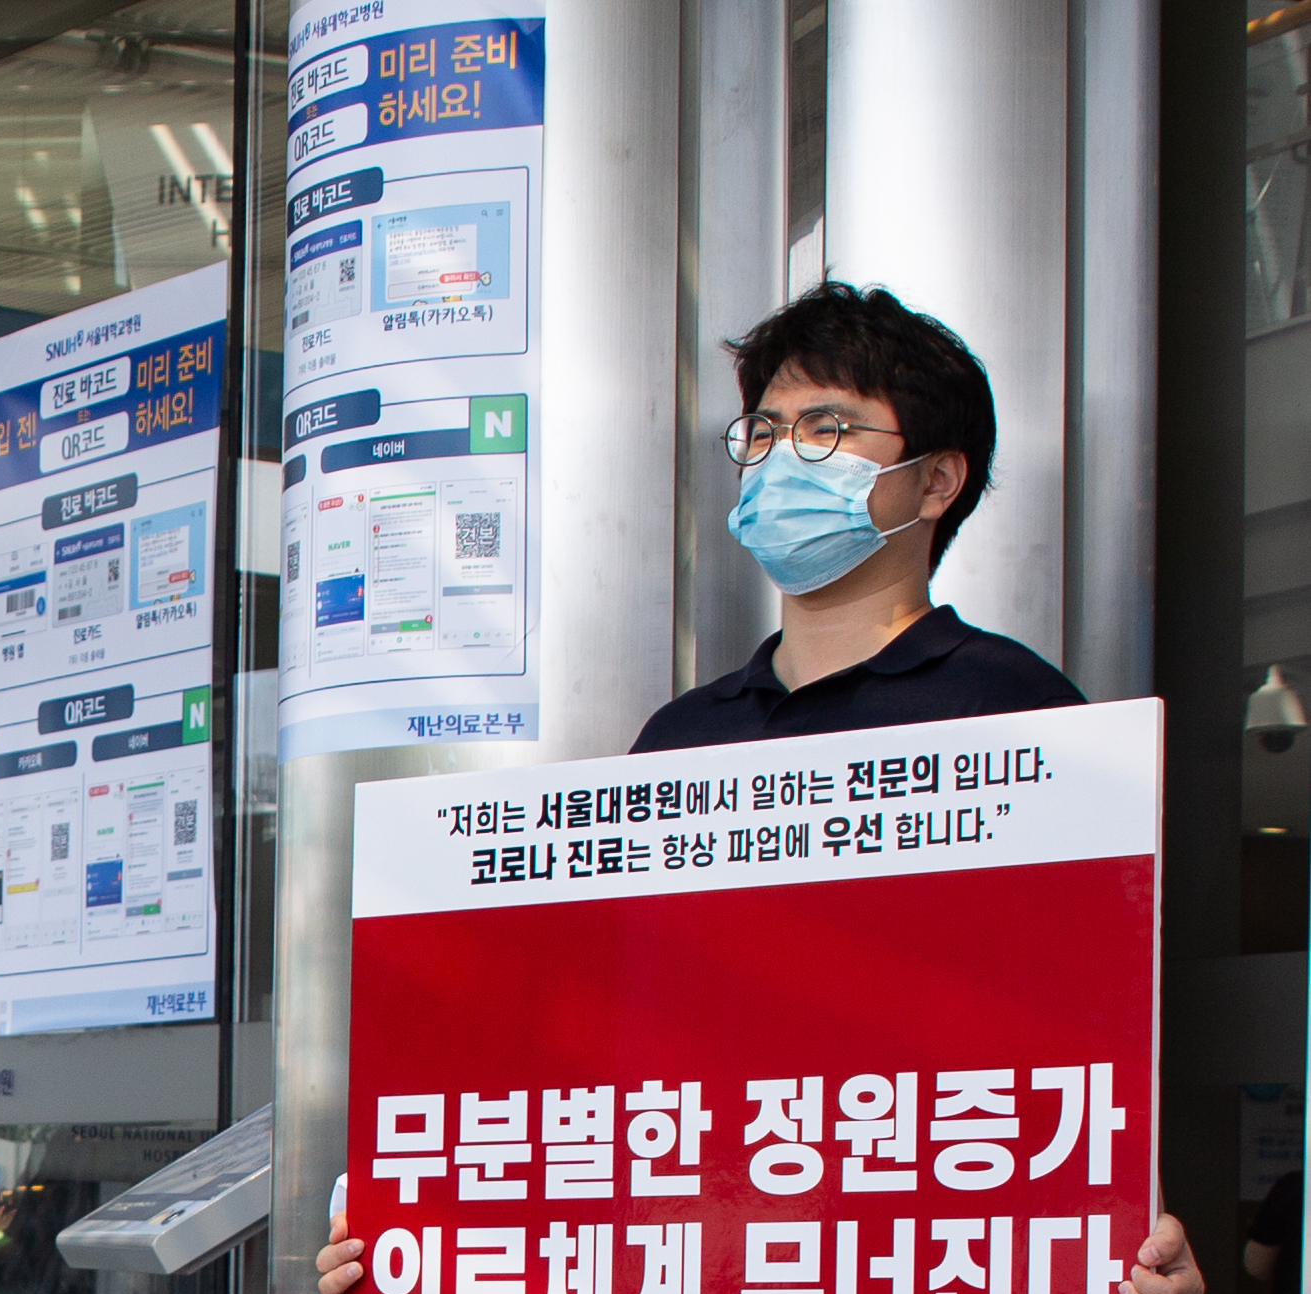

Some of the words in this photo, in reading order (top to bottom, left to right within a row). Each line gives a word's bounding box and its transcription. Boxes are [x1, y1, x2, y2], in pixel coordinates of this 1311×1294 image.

[312, 1, 384, 38] 서울대학교병원
[379, 38, 437, 82] 미리
[450, 30, 518, 74] 준비
[307, 57, 349, 94] 바코드
[378, 81, 482, 128] 하세요!
[294, 119, 336, 162] QR코드
[312, 179, 353, 214] 바코드
[382, 305, 493, 332] 알림톡(카카오톡)
[46, 337, 76, 362] SNUH
[137, 350, 170, 392] 미리
[177, 337, 213, 382] 준비
[80, 366, 117, 400] 바코드
[135, 386, 194, 437] 하세요!
[296, 403, 338, 438] QR코드
[484, 410, 513, 438] N
[17, 412, 37, 450] 전!
[62, 424, 106, 461] QR코드
[372, 439, 405, 458] 네이버
[84, 483, 119, 515] 바코드
[136, 601, 197, 630] 알림톡(카카오톡)
[65, 695, 107, 727] QR코드
[190, 701, 205, 730] N
[408, 712, 525, 738] 재난의료본부
[536, 777, 739, 831] 서울대병원에서
[751, 770, 835, 811] 일하는
[846, 753, 940, 802] 전문의
[953, 746, 1052, 791] 입니다.
[471, 842, 557, 886] 코로나
[567, 836, 651, 879] 진료는
[662, 831, 717, 870] 항상
[727, 822, 810, 864] 파업에
[822, 812, 883, 858] 우선
[147, 990, 208, 1016] 재난의료본부
[71, 1124, 115, 1140] SEOUL
[372, 1079, 713, 1204] 무분별한
[743, 1061, 1127, 1196] 정원증가
